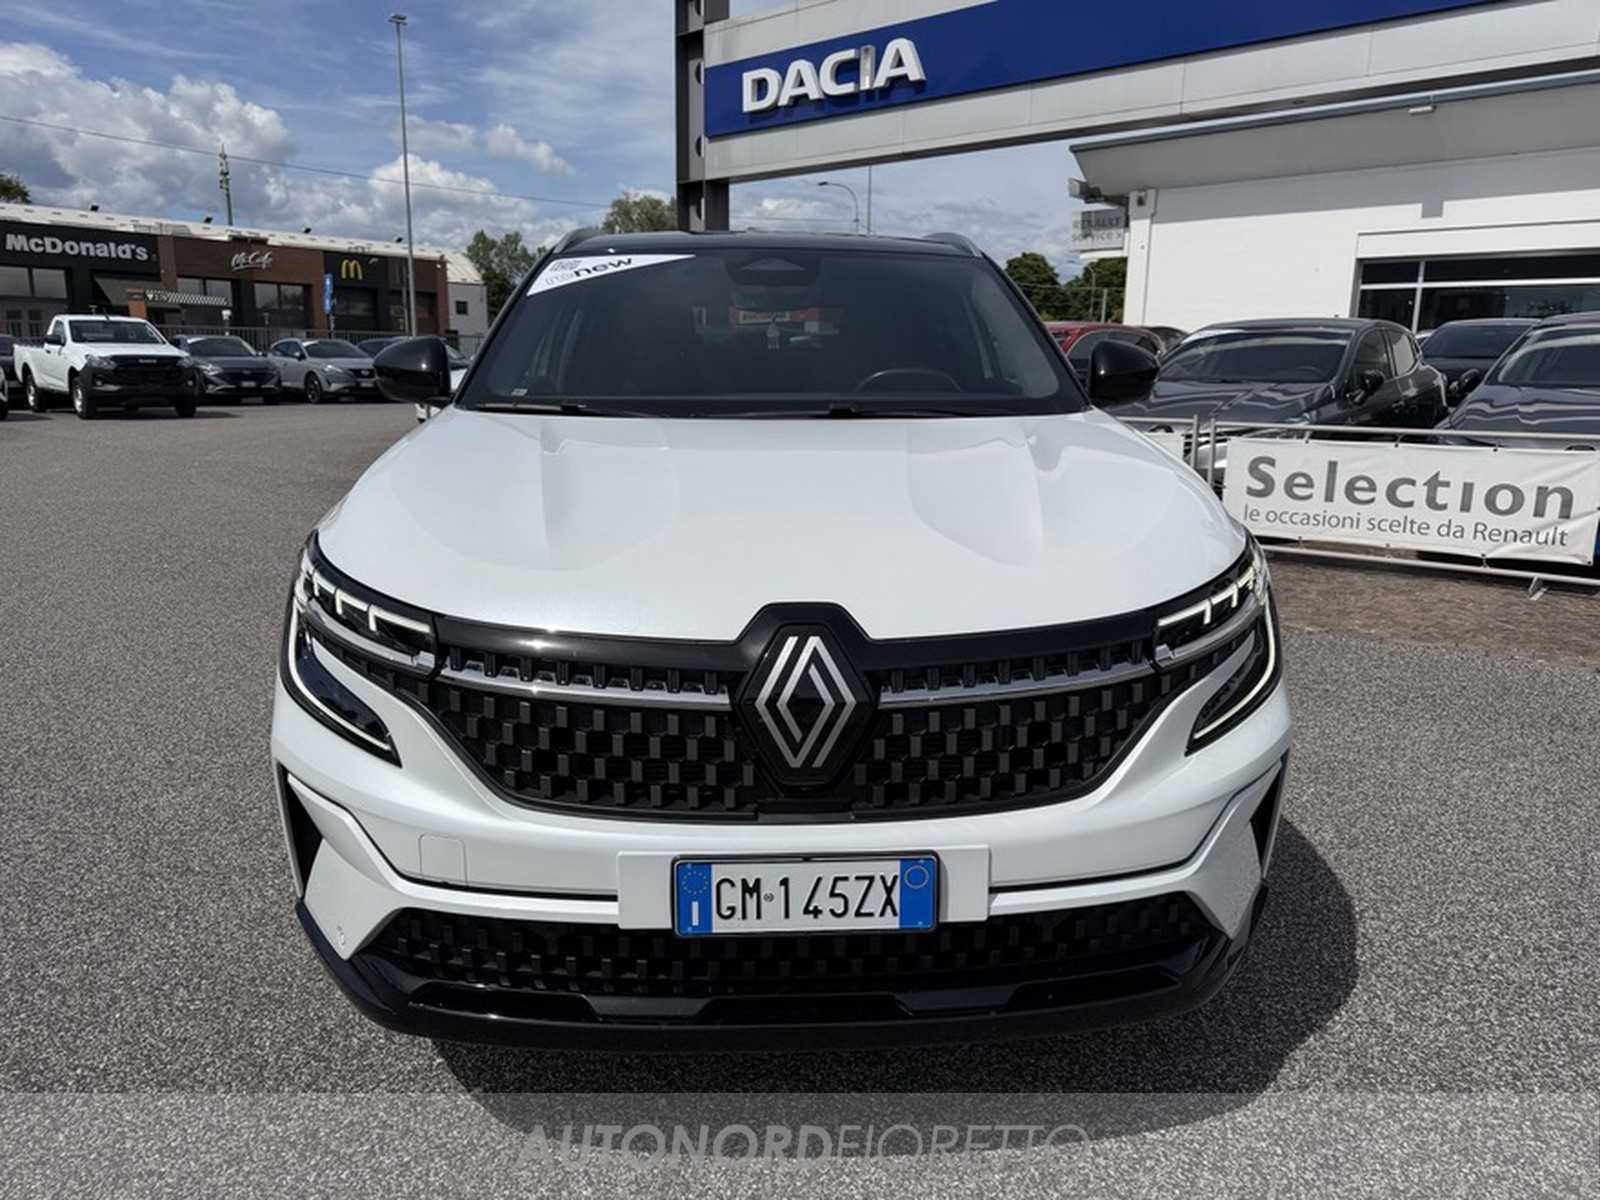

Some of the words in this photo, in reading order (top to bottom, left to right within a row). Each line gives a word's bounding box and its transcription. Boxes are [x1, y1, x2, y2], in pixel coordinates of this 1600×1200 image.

[742, 37, 926, 113] DACIA
[5, 233, 149, 261] McDonald's
[1246, 455, 1575, 520] Selection
[1243, 503, 1261, 522] le
[1264, 507, 1361, 531] occasioni
[1367, 514, 1430, 537] scelte
[1437, 517, 1466, 539] da
[1472, 521, 1569, 548] Renault
